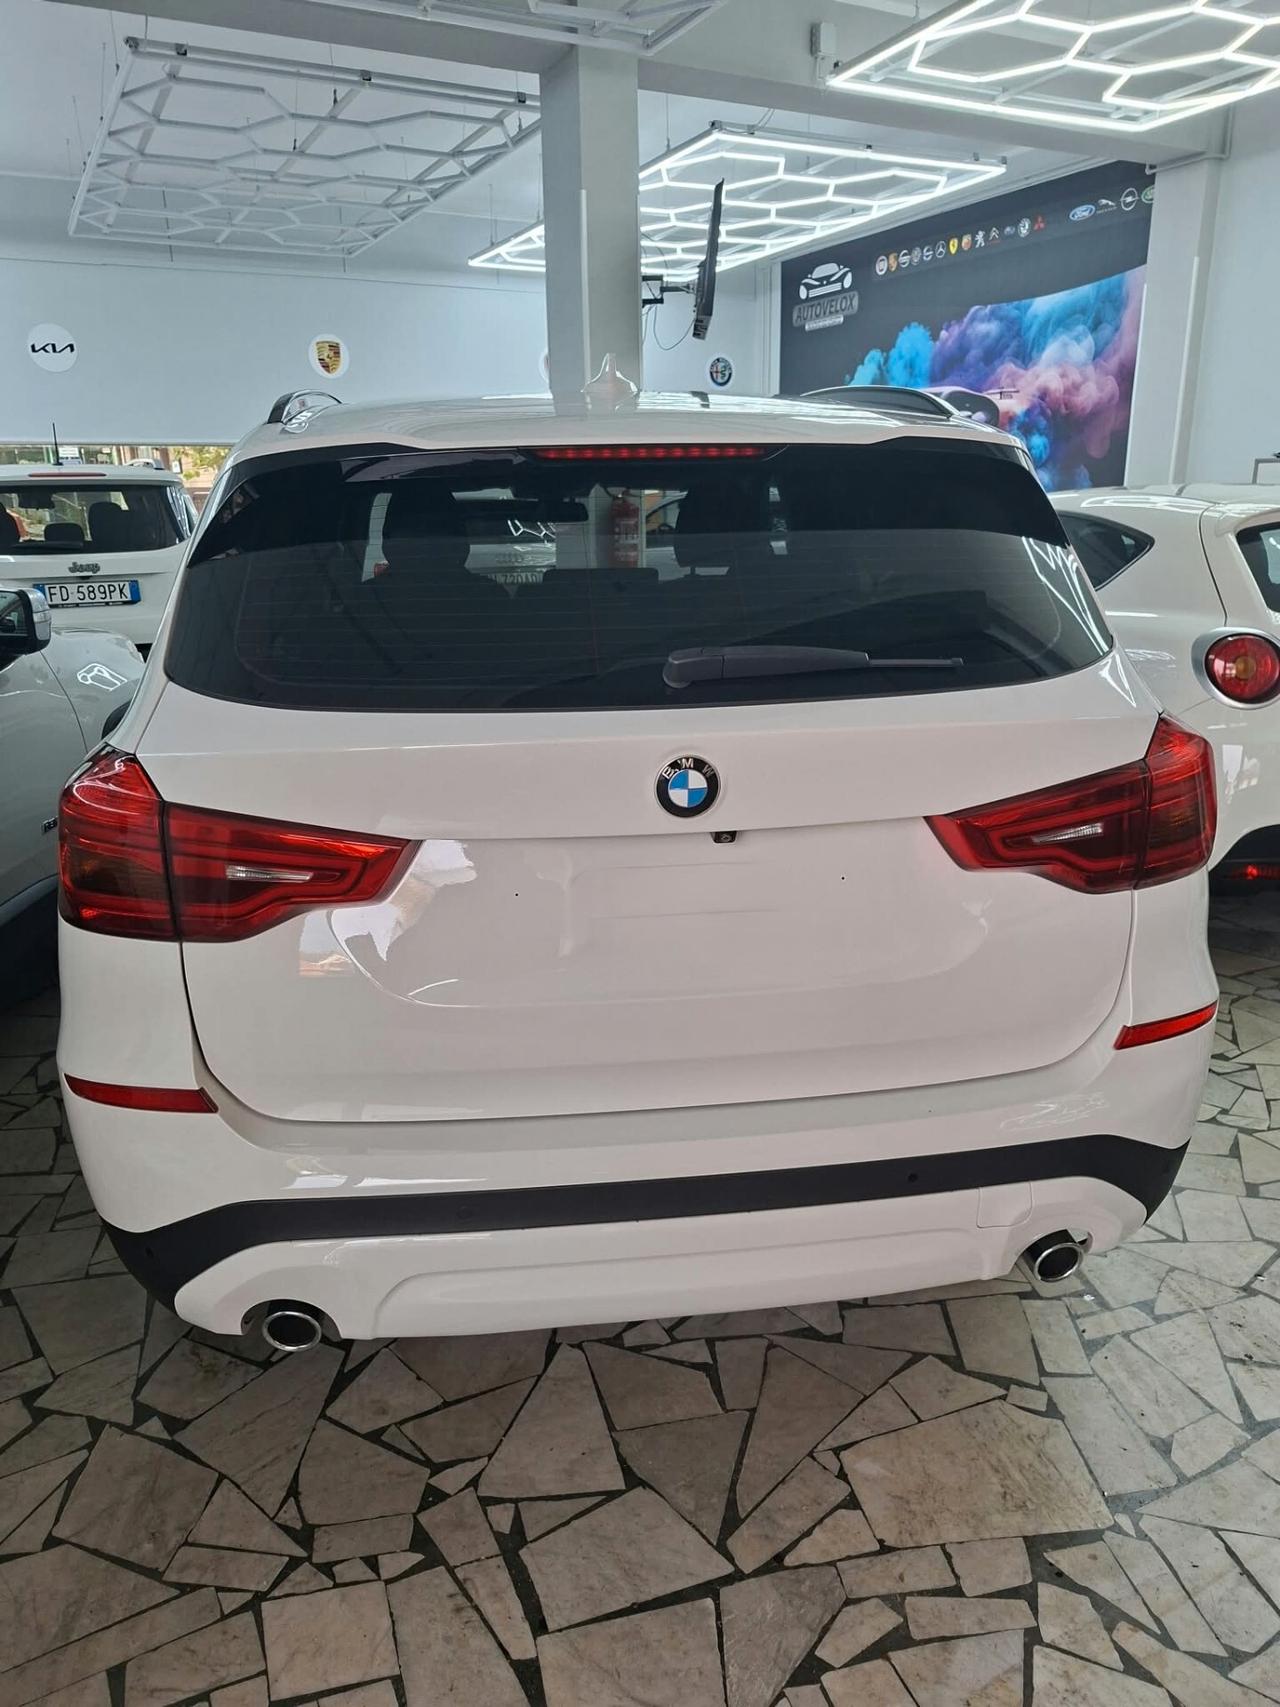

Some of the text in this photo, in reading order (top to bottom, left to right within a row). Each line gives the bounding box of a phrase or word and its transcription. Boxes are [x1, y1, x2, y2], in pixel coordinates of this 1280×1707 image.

[795, 293, 856, 326] AUTOVELOX
[68, 562, 101, 574] Jeep
[48, 583, 128, 602] FD 589PK
[662, 758, 715, 780] BMW
